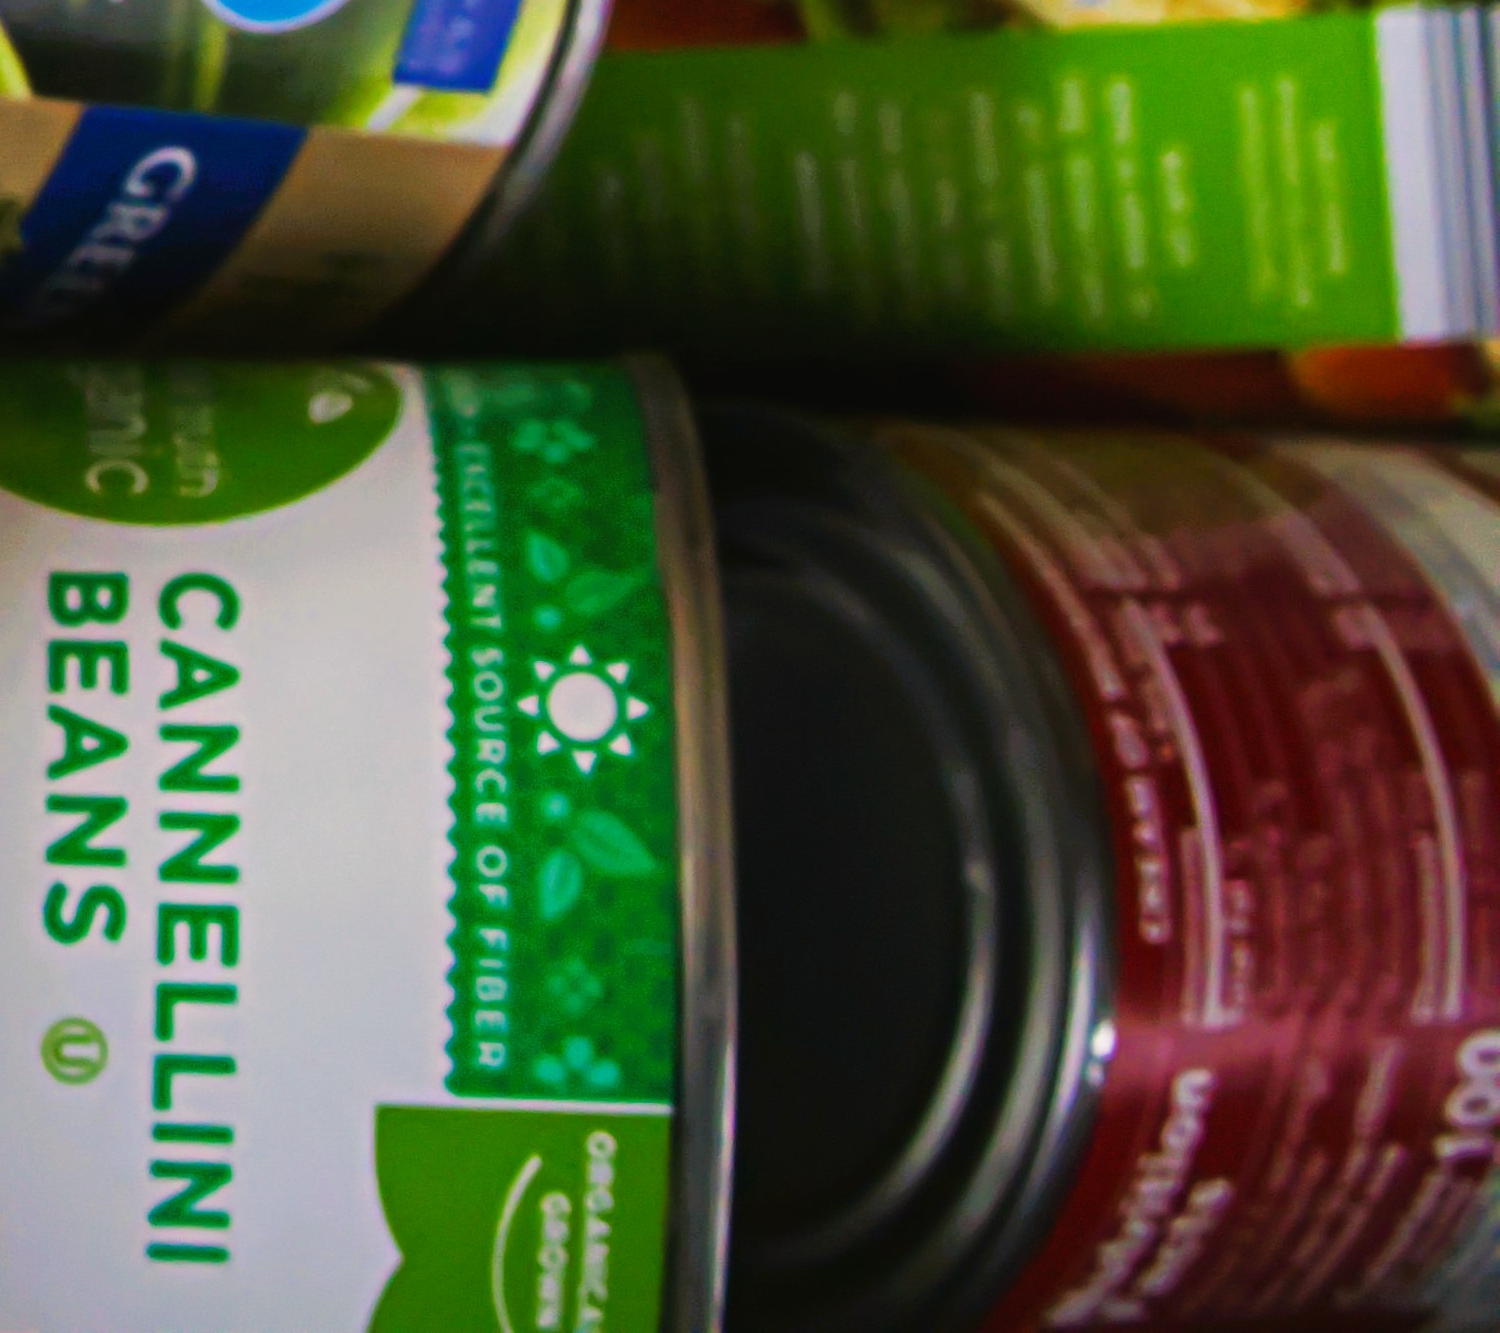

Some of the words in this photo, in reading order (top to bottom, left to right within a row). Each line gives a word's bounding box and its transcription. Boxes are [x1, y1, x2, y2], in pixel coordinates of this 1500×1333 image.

[459, 441, 503, 637] EXCELLENT
[43, 569, 131, 945] BEANS
[471, 648, 507, 826] SOURCE
[144, 571, 242, 1265] CANNELLINI
[473, 847, 508, 913] OF
[472, 931, 508, 1070] FIBER
